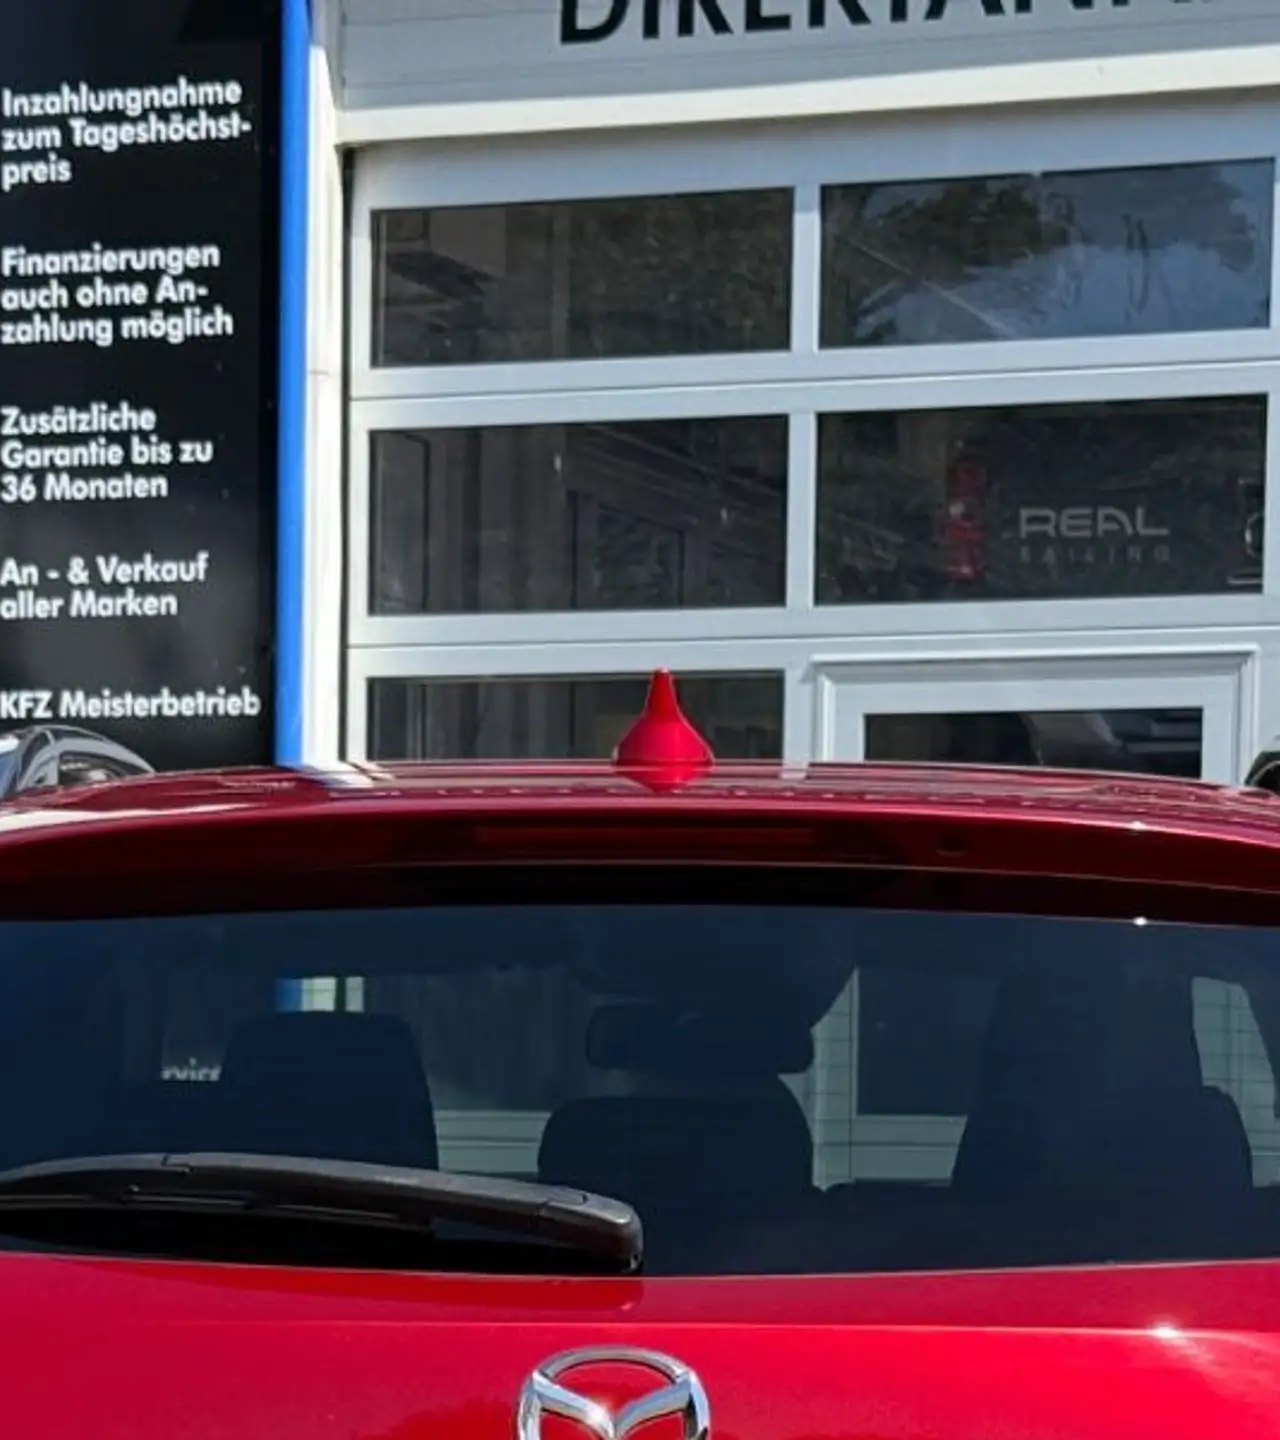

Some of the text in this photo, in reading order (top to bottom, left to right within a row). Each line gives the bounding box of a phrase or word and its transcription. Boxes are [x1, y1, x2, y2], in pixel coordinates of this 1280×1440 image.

[1, 75, 243, 117] Inzahlungnahme
[1, 111, 252, 152] zum Tageshöchst-
[1, 153, 72, 191] preis
[1, 242, 220, 278] Finanzierungen
[1, 273, 208, 311] auch ohne An-
[0, 305, 234, 347] zahlung möglich
[0, 401, 157, 435] Zusätzliche
[0, 436, 214, 470] Garantie bis zu
[0, 474, 169, 503] 36 Monaten
[1019, 505, 1170, 539] REAL
[67, 557, 90, 586] &
[96, 551, 210, 586] Verkauf
[0, 589, 178, 620] aller Marken
[0, 686, 262, 720] KFZ Meisterbetrieb
